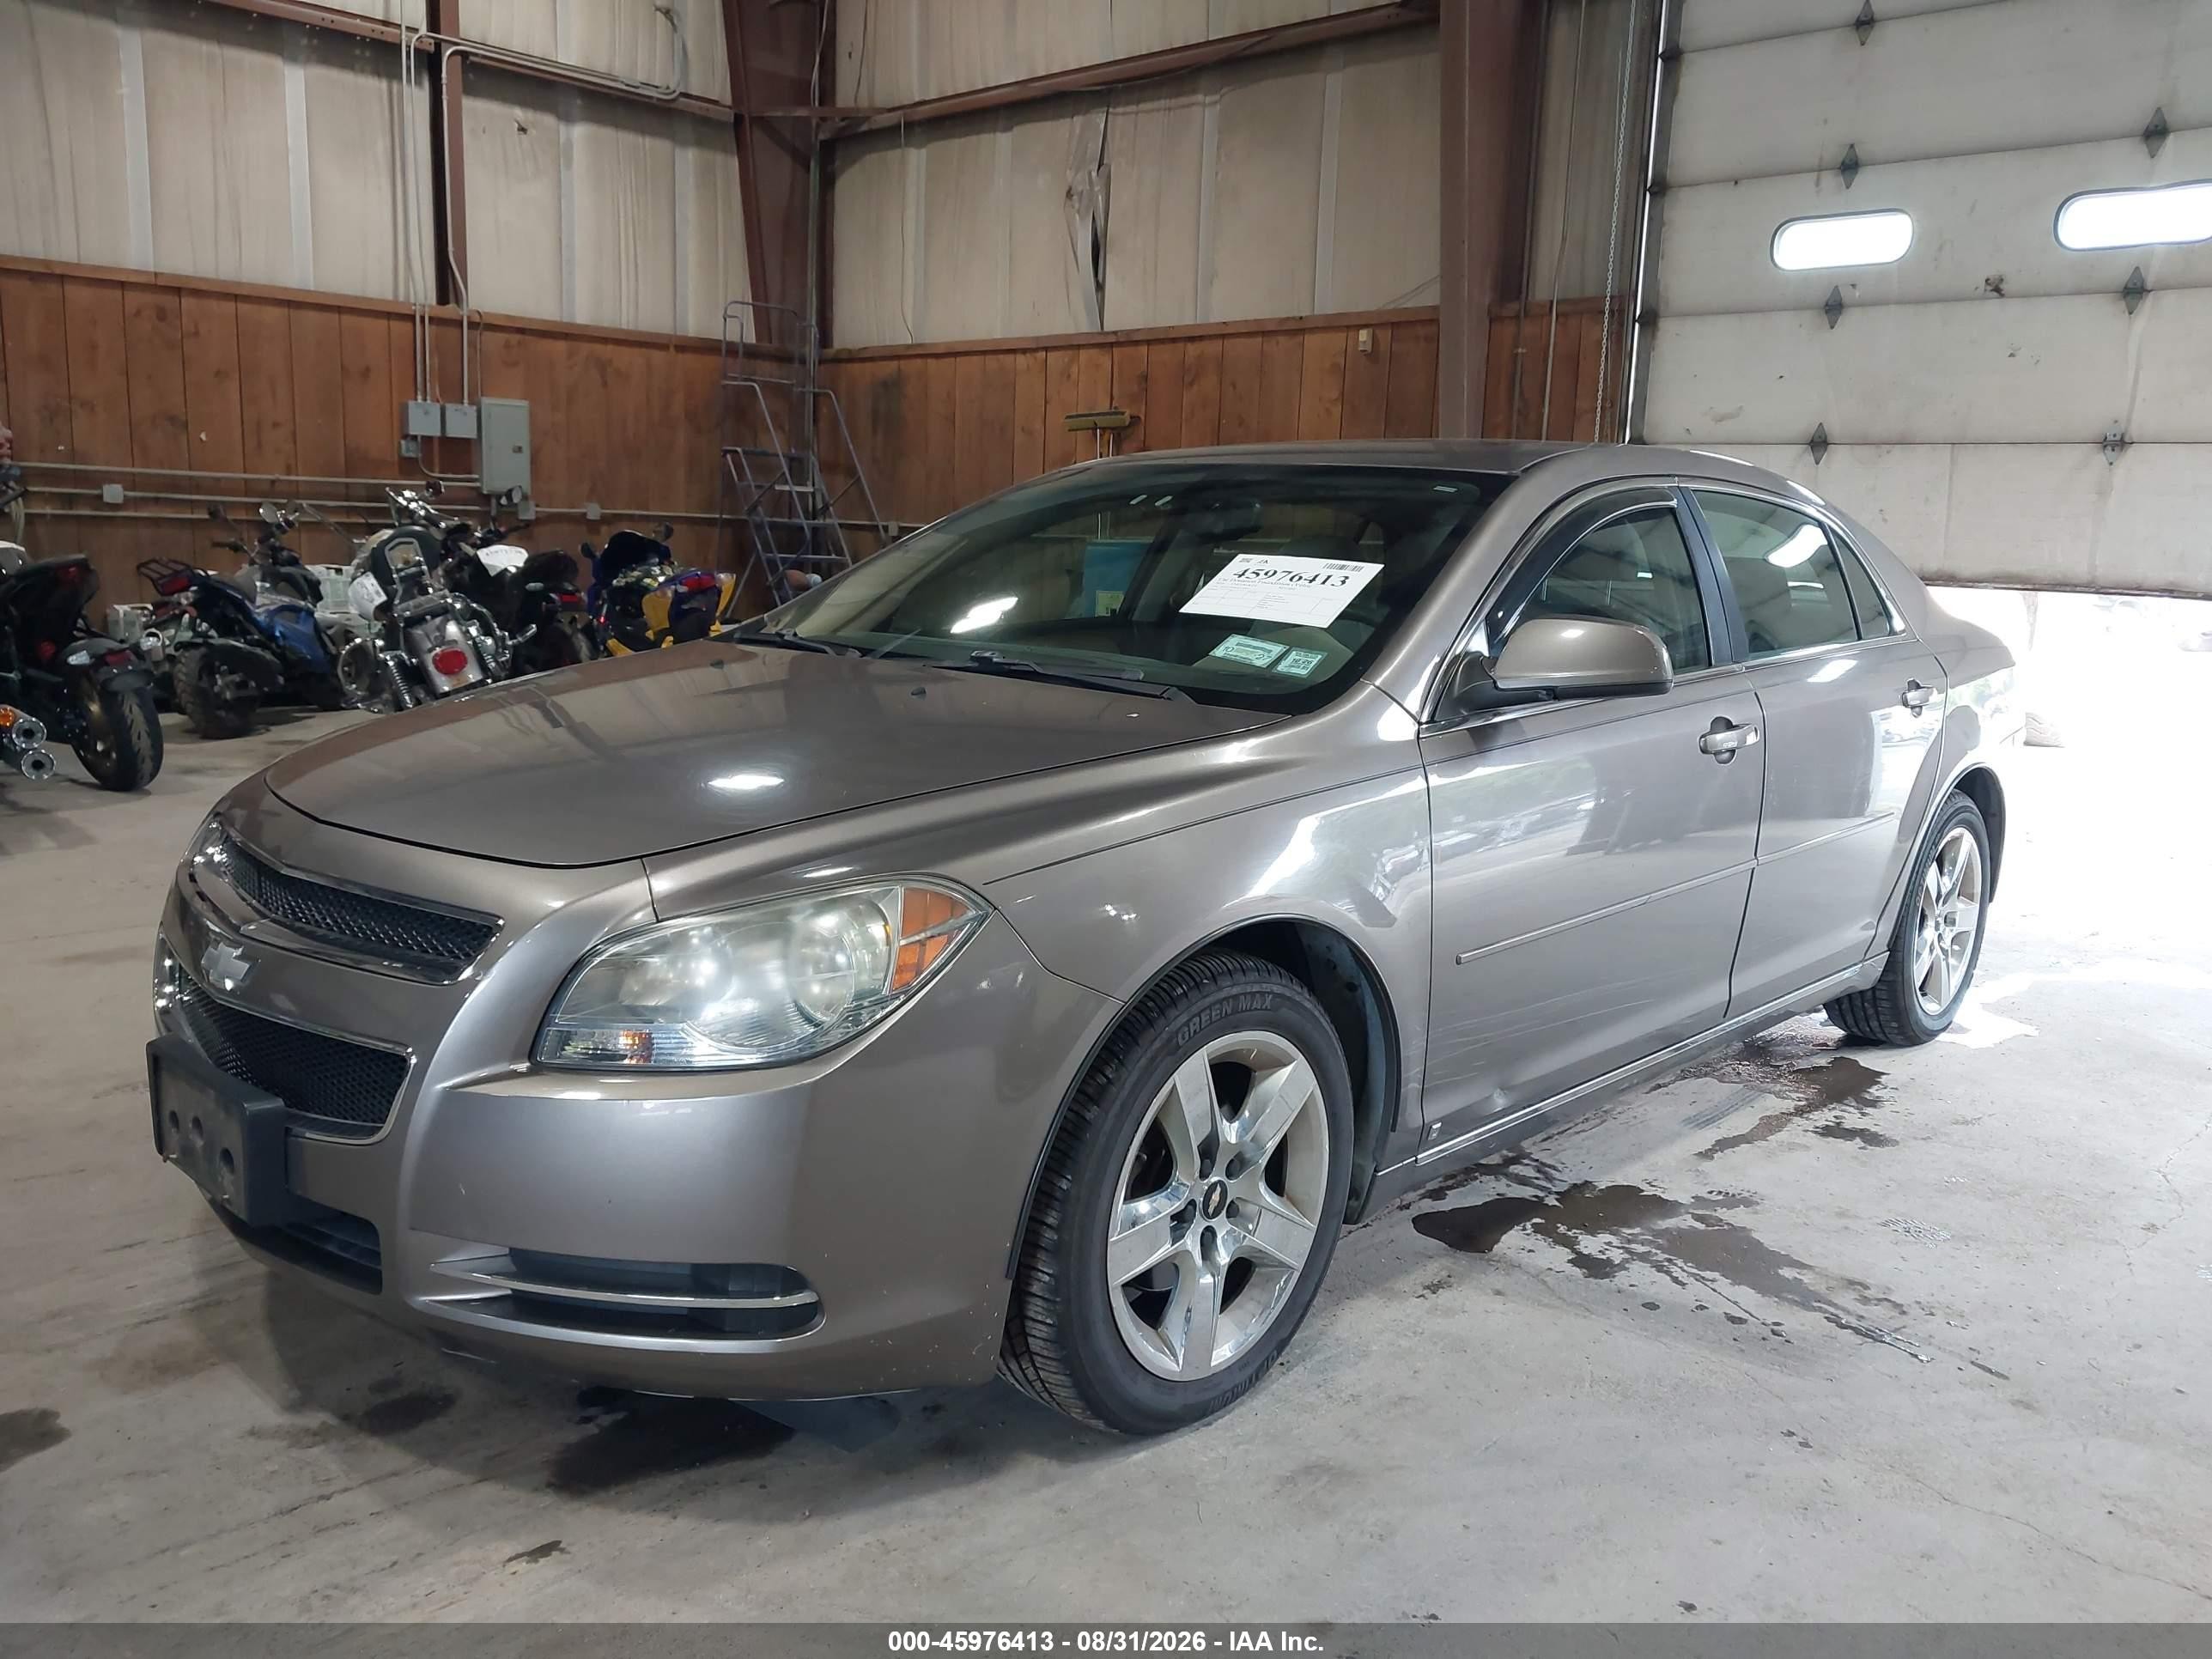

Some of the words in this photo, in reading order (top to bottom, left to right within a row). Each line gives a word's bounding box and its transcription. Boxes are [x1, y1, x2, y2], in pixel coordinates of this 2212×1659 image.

[1233, 568, 1350, 587] 45976413
[1177, 998, 1233, 1047] GREEN
[1237, 994, 1273, 1012] MAX
